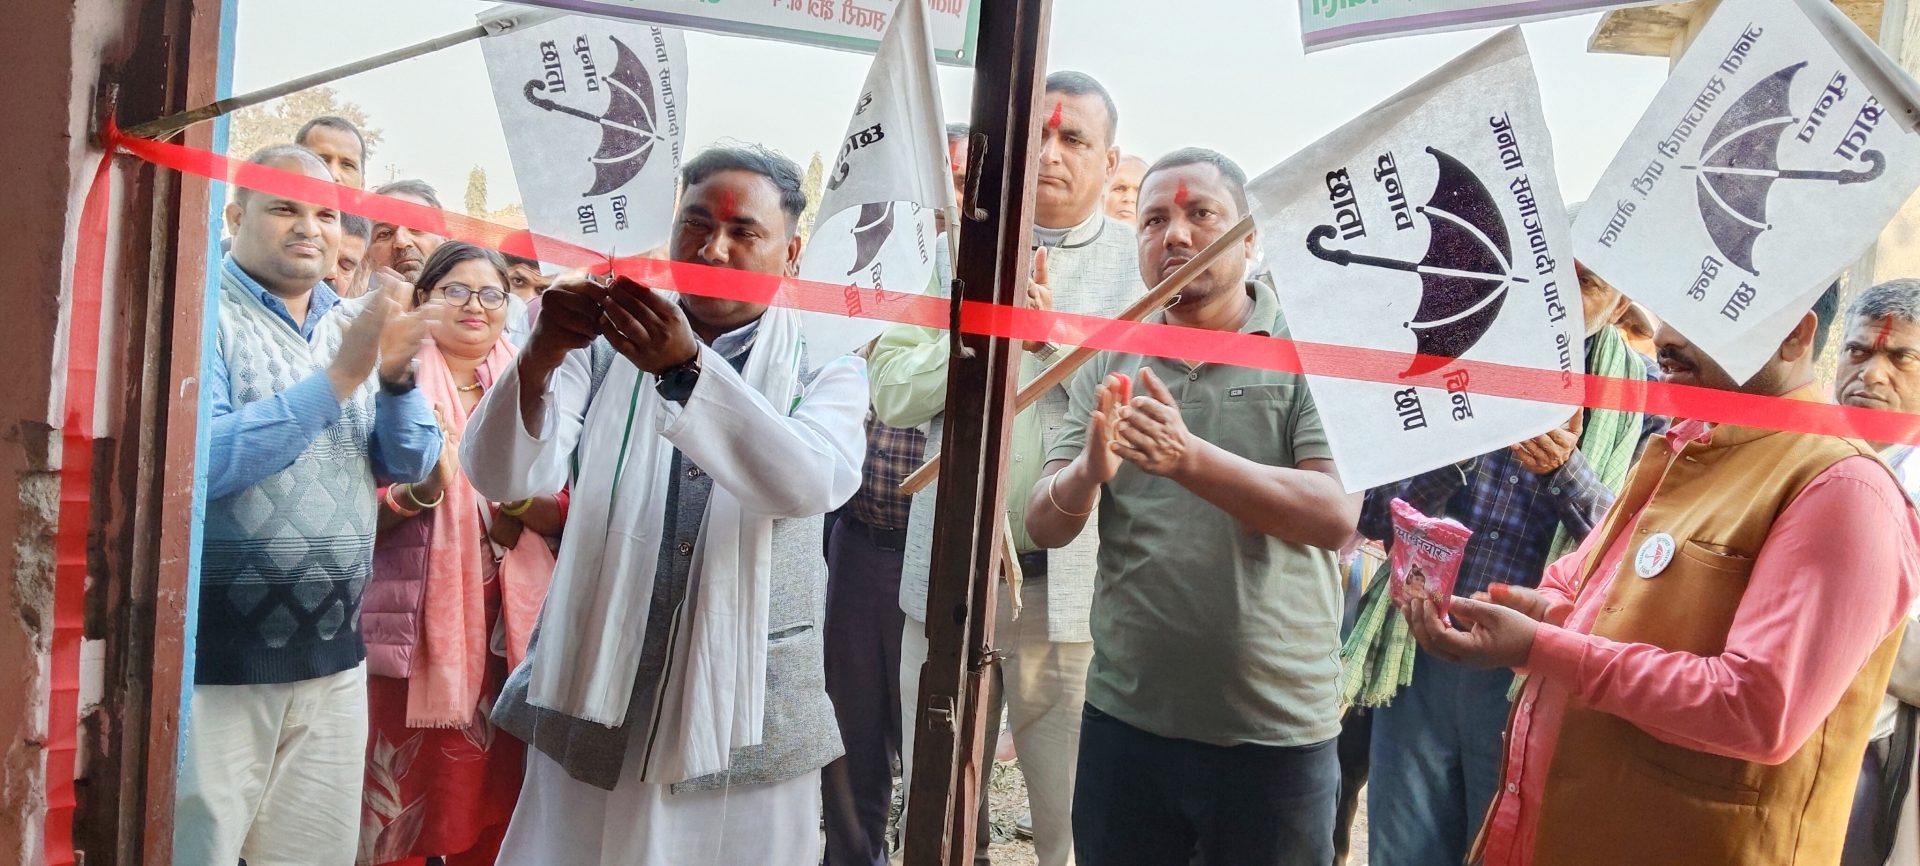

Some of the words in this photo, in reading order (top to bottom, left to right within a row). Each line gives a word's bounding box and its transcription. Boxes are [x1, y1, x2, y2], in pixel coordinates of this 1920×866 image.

[540, 40, 566, 93] छाता
[574, 34, 600, 92] चुनाव
[650, 25, 668, 62] जनता
[659, 67, 678, 138] समाजवादी
[577, 204, 598, 234] छाप
[1326, 167, 1367, 242] छाता
[1374, 151, 1415, 232] चुनाव
[1490, 112, 1524, 171] जनता
[1508, 174, 1555, 276] समाजवादी
[1555, 332, 1573, 389] नेपाल
[1394, 386, 1428, 432] छाप
